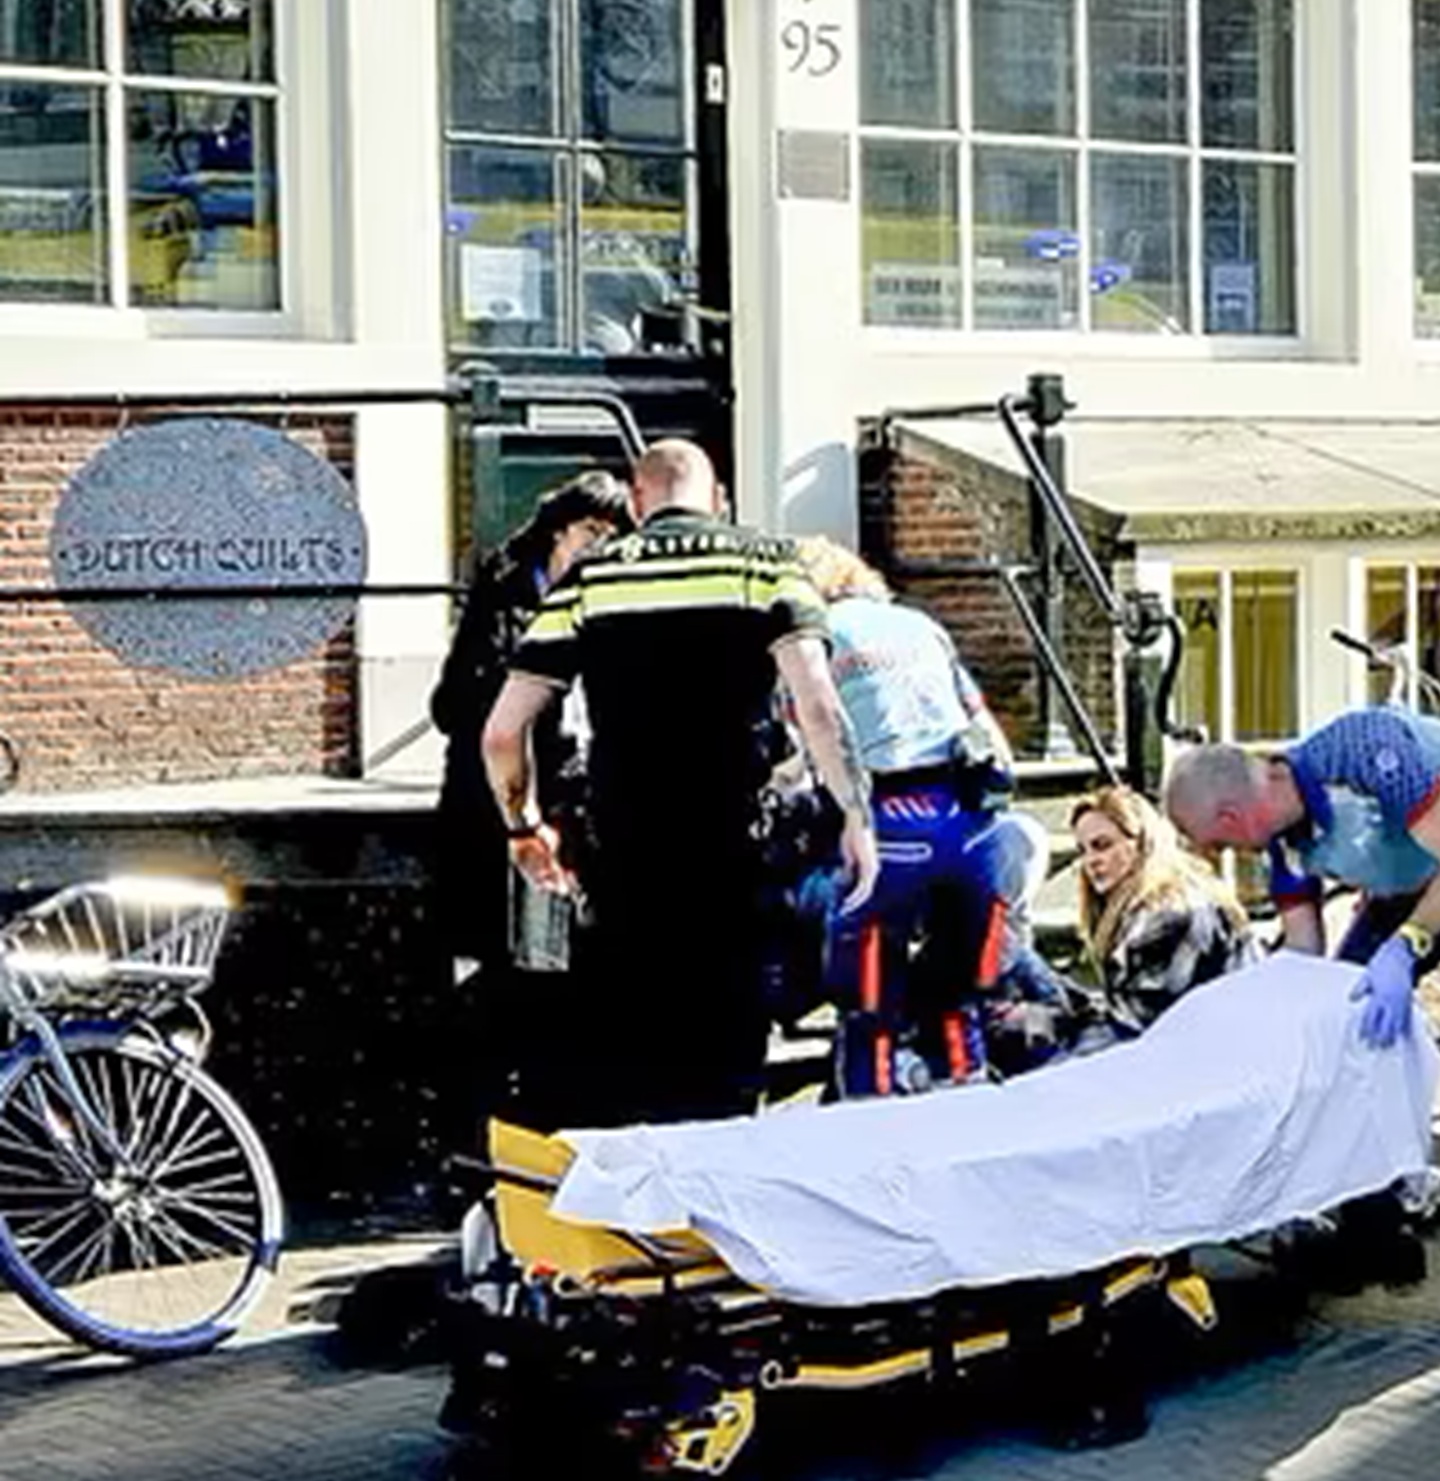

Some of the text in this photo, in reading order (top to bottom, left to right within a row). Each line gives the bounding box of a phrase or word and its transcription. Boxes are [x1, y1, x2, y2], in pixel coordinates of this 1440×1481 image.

[780, 19, 841, 77] 95
[67, 537, 345, 576] DUTCH QUILTS
